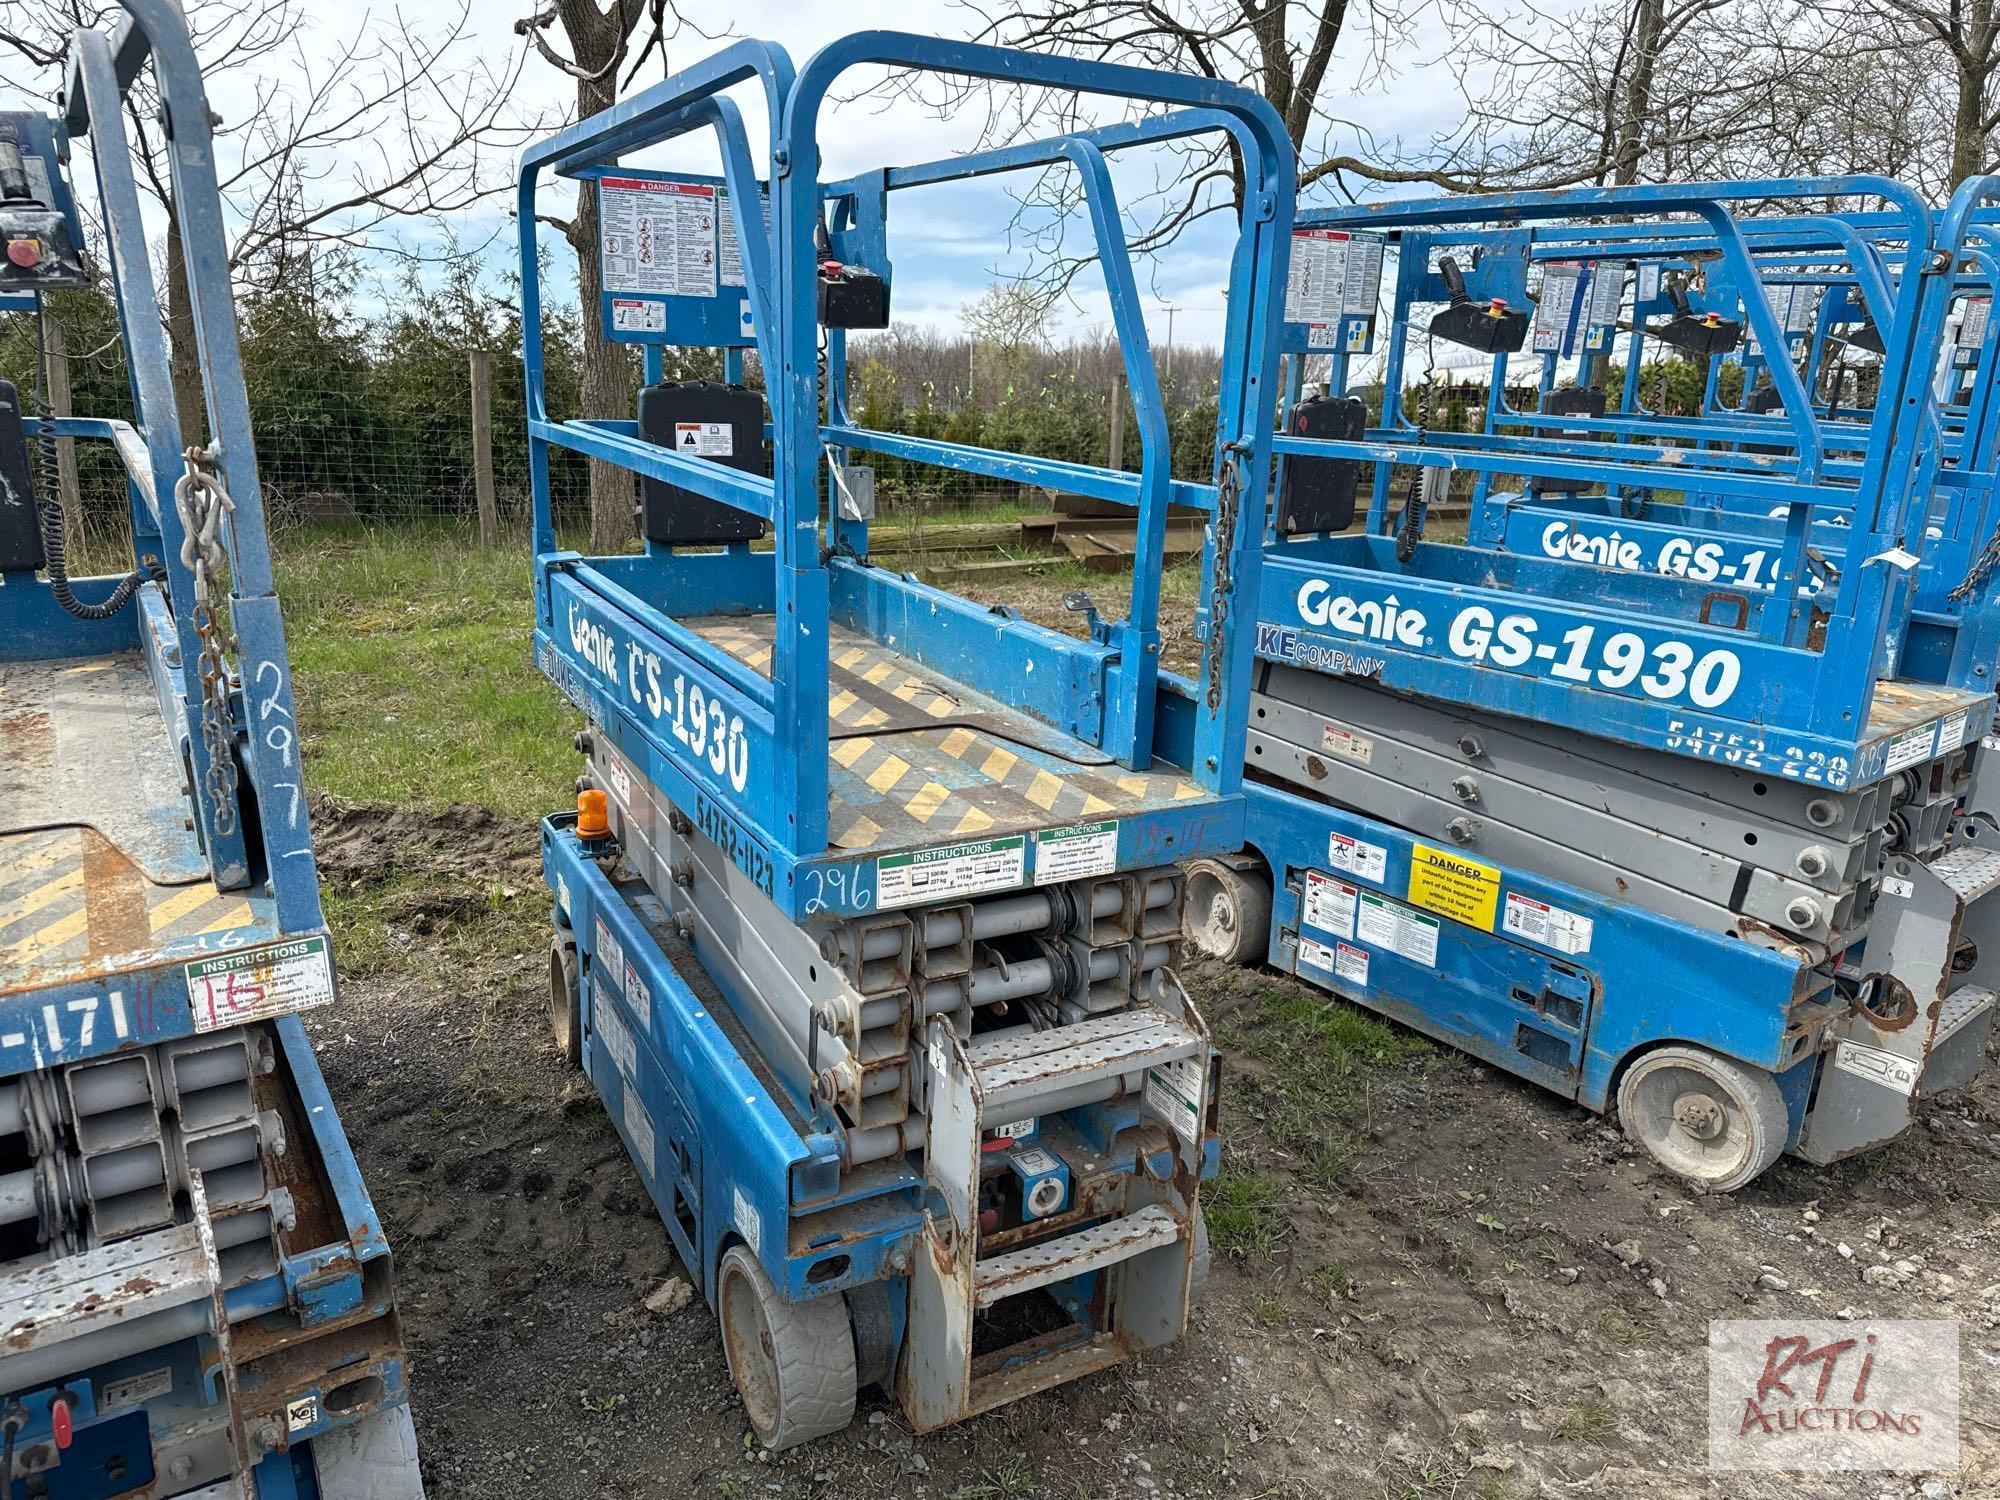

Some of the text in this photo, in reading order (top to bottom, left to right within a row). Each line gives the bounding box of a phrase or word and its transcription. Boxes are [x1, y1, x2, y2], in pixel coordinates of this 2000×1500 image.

[648, 183, 680, 192] DANGER
[1542, 521, 1642, 571] Genie
[1297, 579, 1741, 708] Genie GS-1930
[1296, 643, 1385, 677] COMPANY
[256, 660, 299, 830] 297
[1857, 741, 1885, 779] 295
[1054, 824, 1101, 838] INSTRUCTIONS
[913, 842, 991, 863] INSTRUCTIONS
[881, 874, 901, 882] Platform
[1421, 868, 1446, 880] Unlawful
[1454, 879, 1475, 891] operate
[1476, 886, 1487, 895] any
[1430, 855, 1481, 881] DANGER
[805, 865, 871, 913] 296
[1422, 879, 1434, 887] part
[1441, 885, 1452, 893] this
[1453, 889, 1483, 904] equipment
[1429, 892, 1446, 901] within
[202, 943, 308, 974] INSTRUCTIONS
